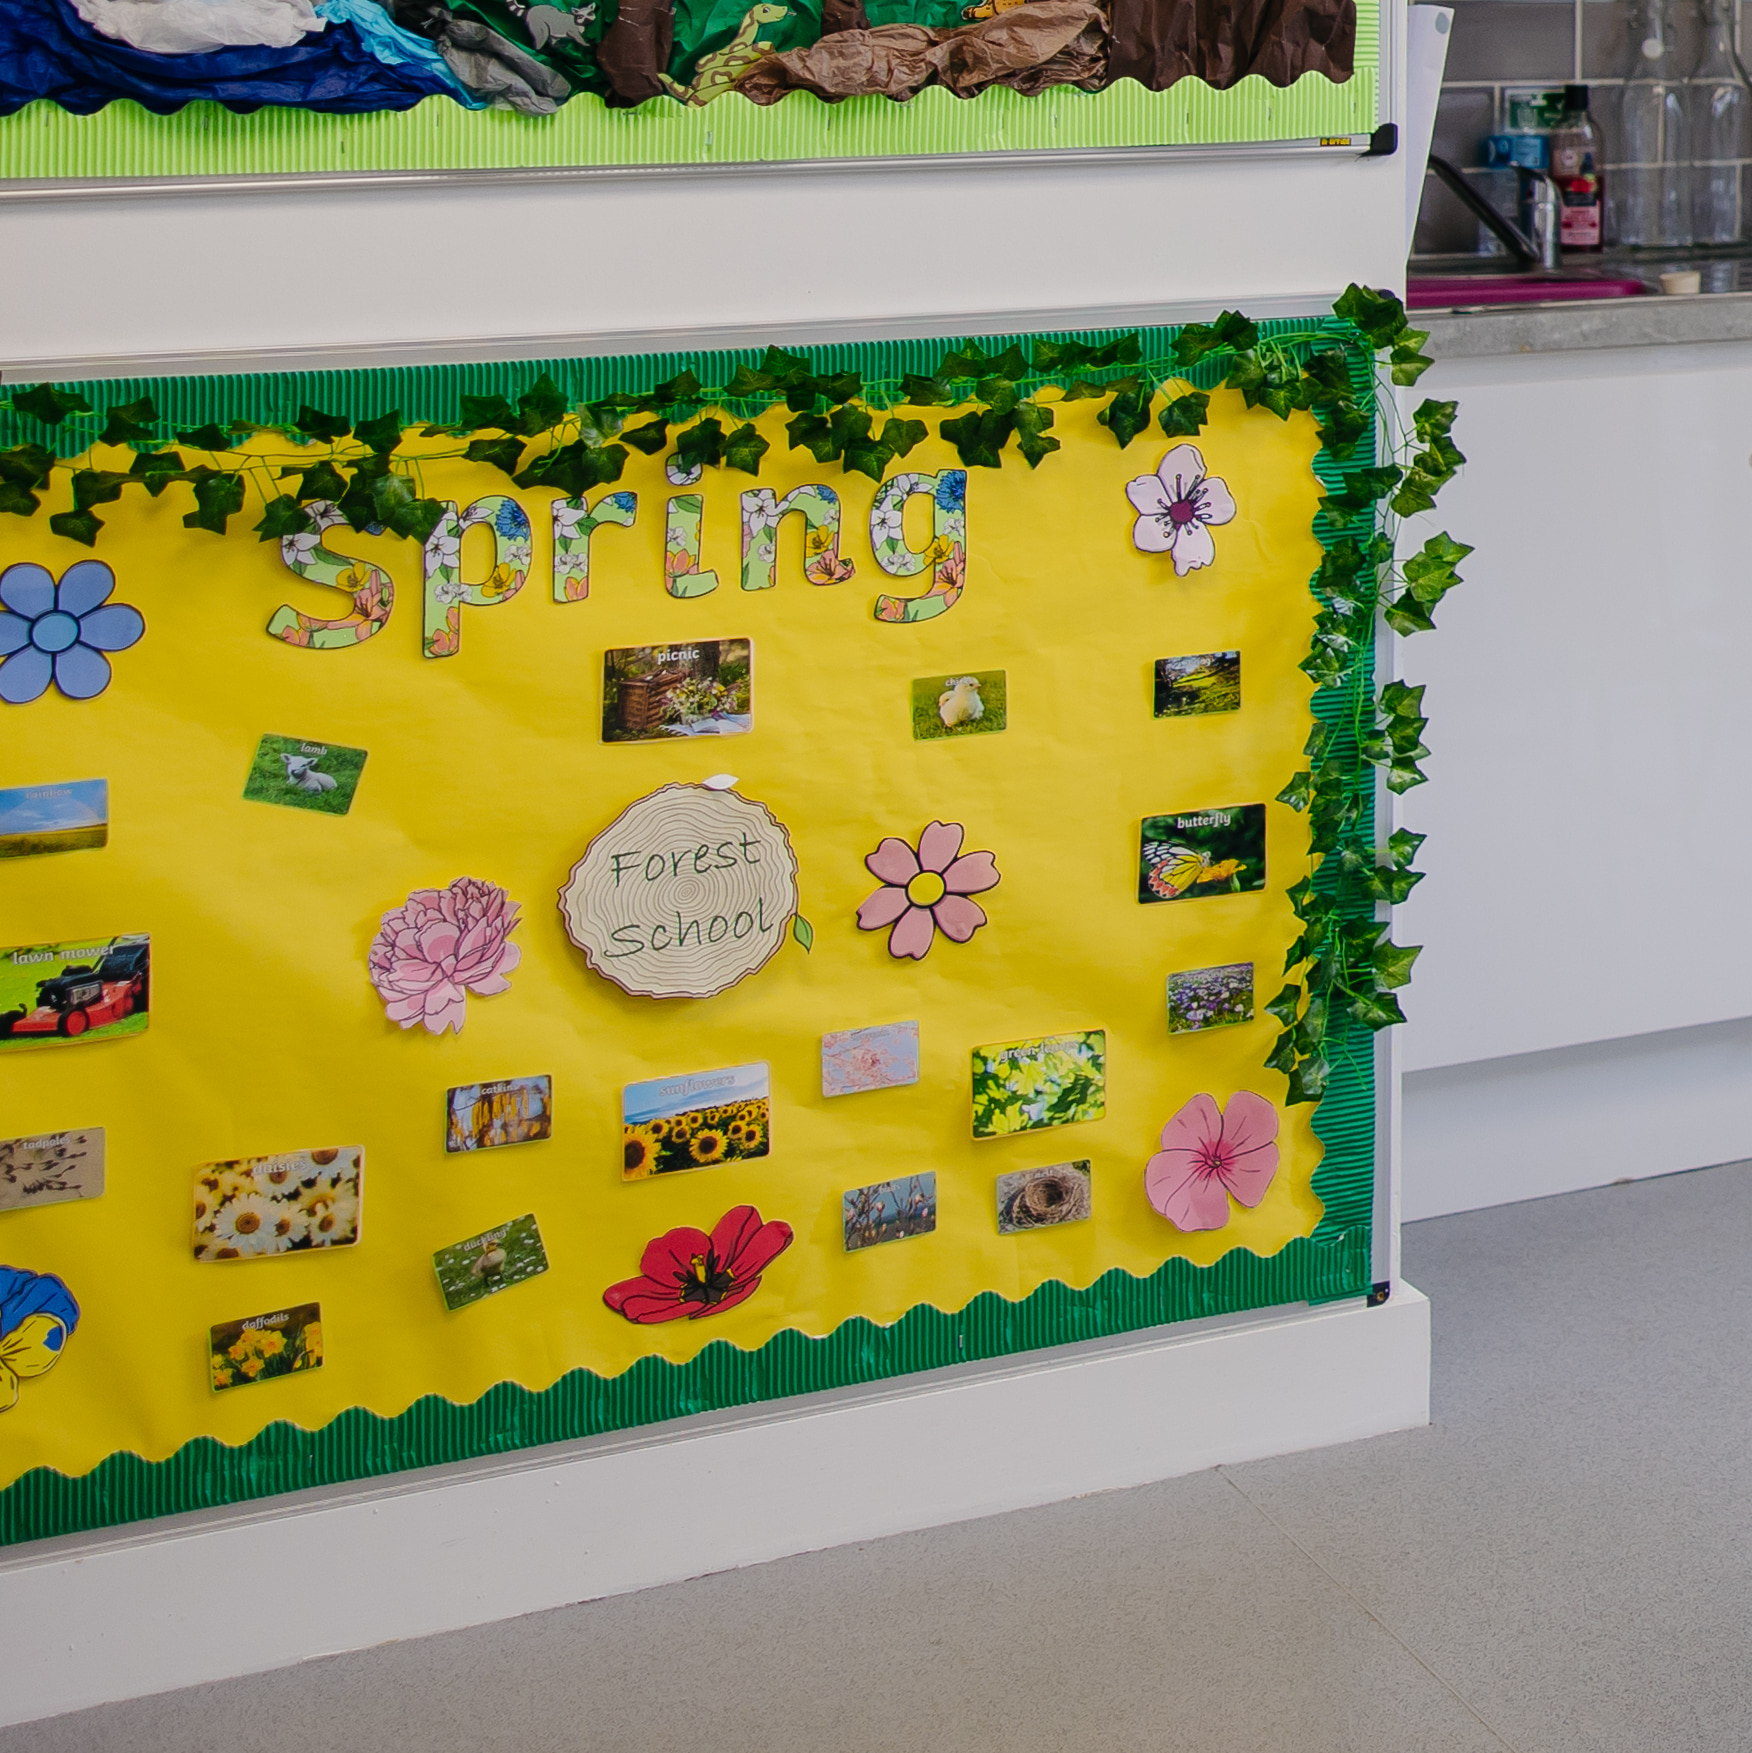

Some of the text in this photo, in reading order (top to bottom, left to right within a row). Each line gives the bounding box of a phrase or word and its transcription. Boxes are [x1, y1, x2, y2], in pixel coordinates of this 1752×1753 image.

[266, 453, 969, 659] Spring
[657, 648, 700, 666] picnic
[300, 742, 328, 756] lamb
[26, 788, 73, 800] rainbow
[1176, 811, 1232, 831] butterfly
[609, 829, 764, 888] Forest
[12, 944, 115, 966] lawn mower
[999, 1044, 1037, 1064] green
[659, 1073, 735, 1097] sunflowers
[22, 1134, 71, 1150] tadpoles
[251, 1158, 307, 1176] daisies
[463, 1228, 508, 1252] duckling
[241, 1311, 290, 1331] daffodils
